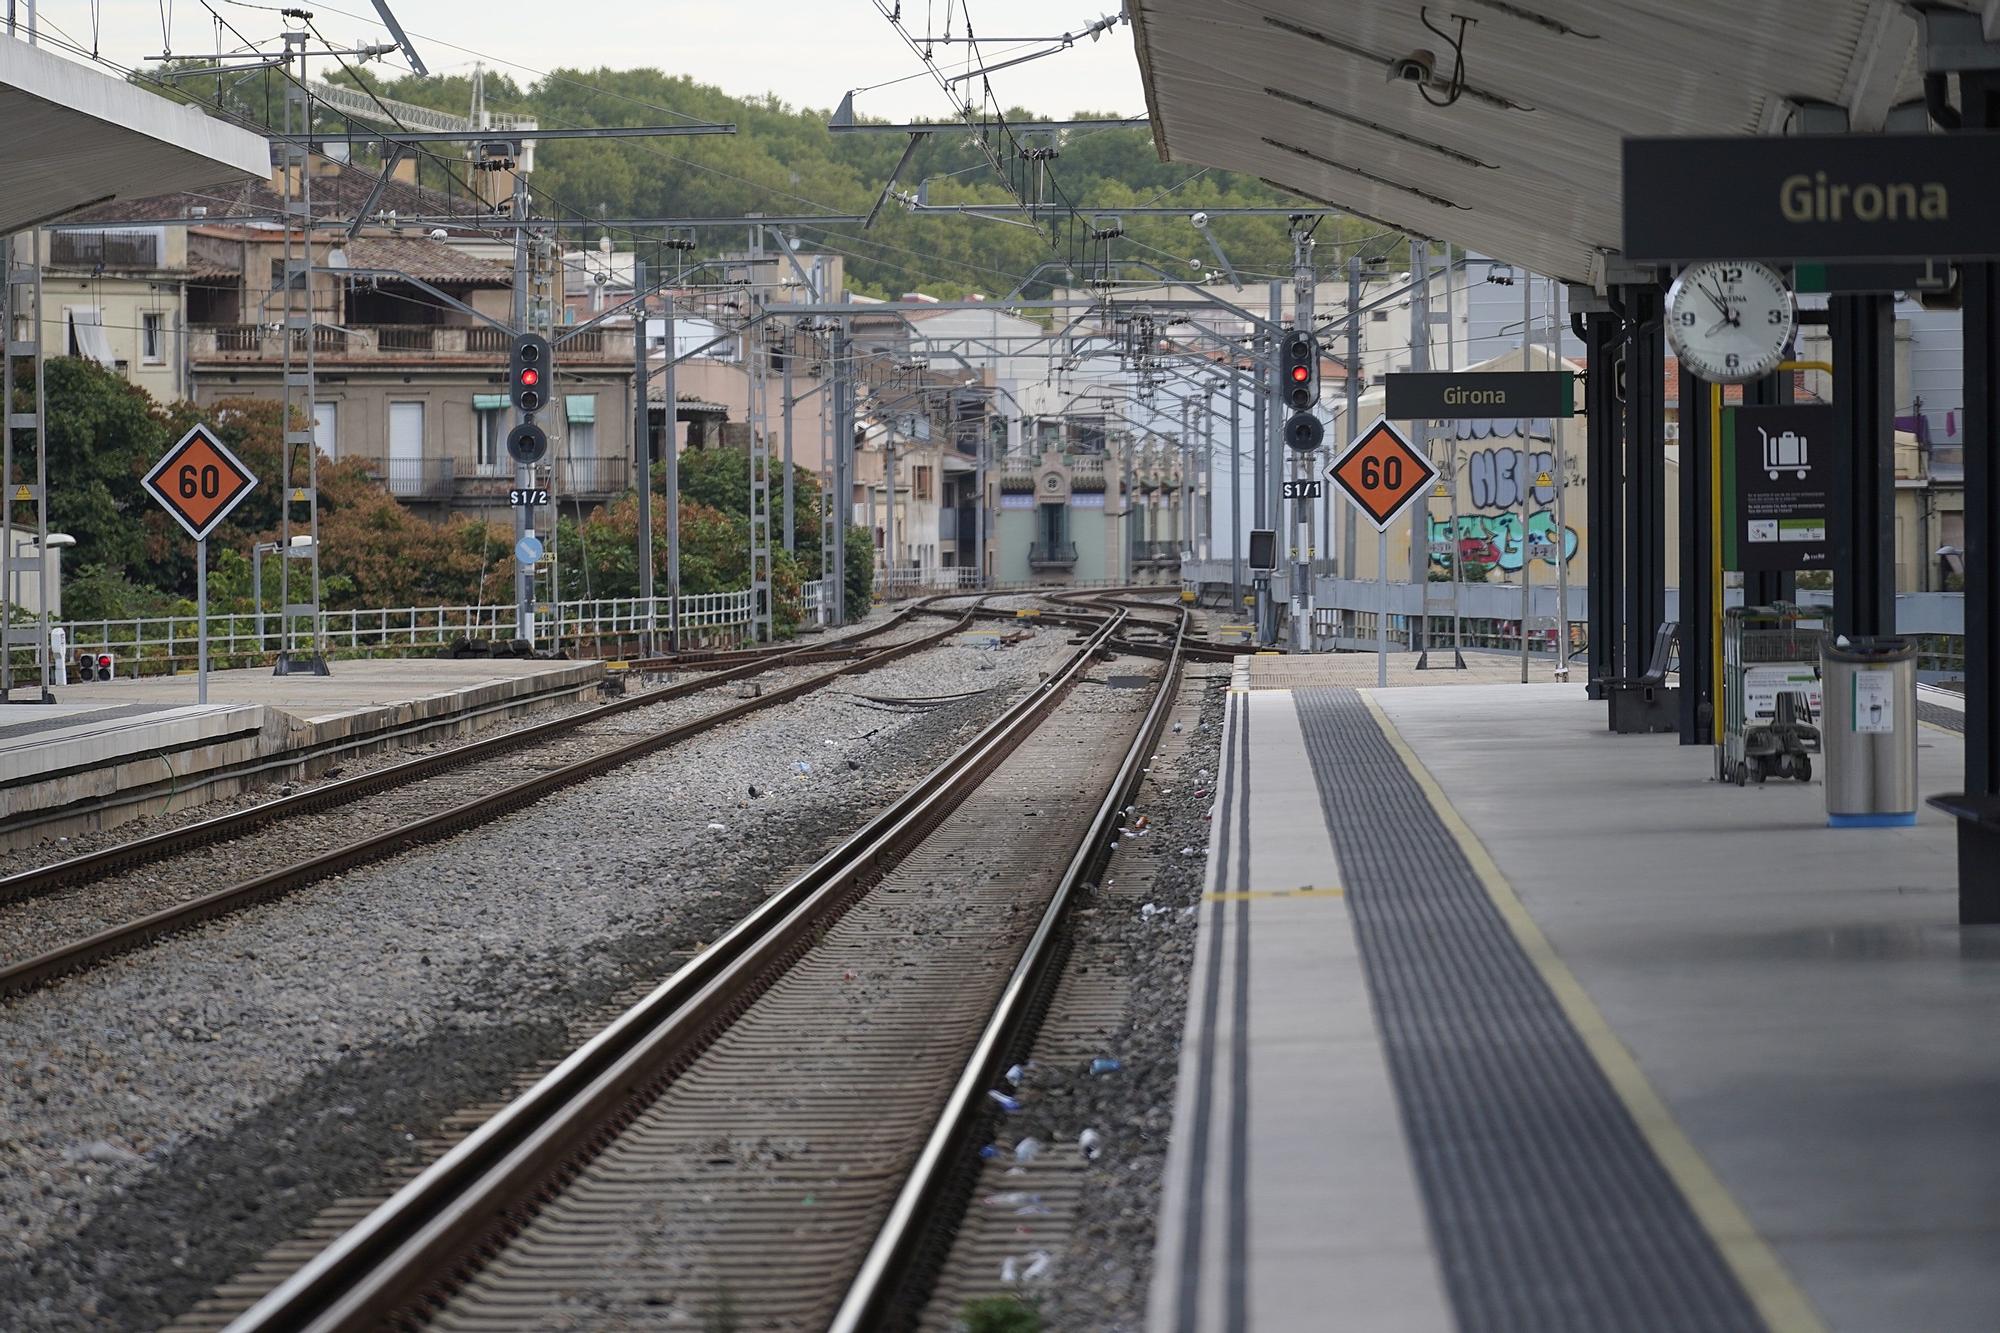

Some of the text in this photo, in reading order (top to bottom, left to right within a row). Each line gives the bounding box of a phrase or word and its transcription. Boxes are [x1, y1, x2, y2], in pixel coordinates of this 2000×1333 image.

[1780, 171, 1949, 222] Girona
[1722, 267, 1743, 283] 12
[1681, 311, 1696, 327] 9
[1767, 309, 1782, 325] 3
[1725, 353, 1739, 368] 6
[1443, 386, 1506, 404] Girona
[1361, 455, 1402, 490] 60
[179, 464, 220, 499] 60
[510, 491, 547, 504] S1/2
[1284, 483, 1320, 497] S1/1
